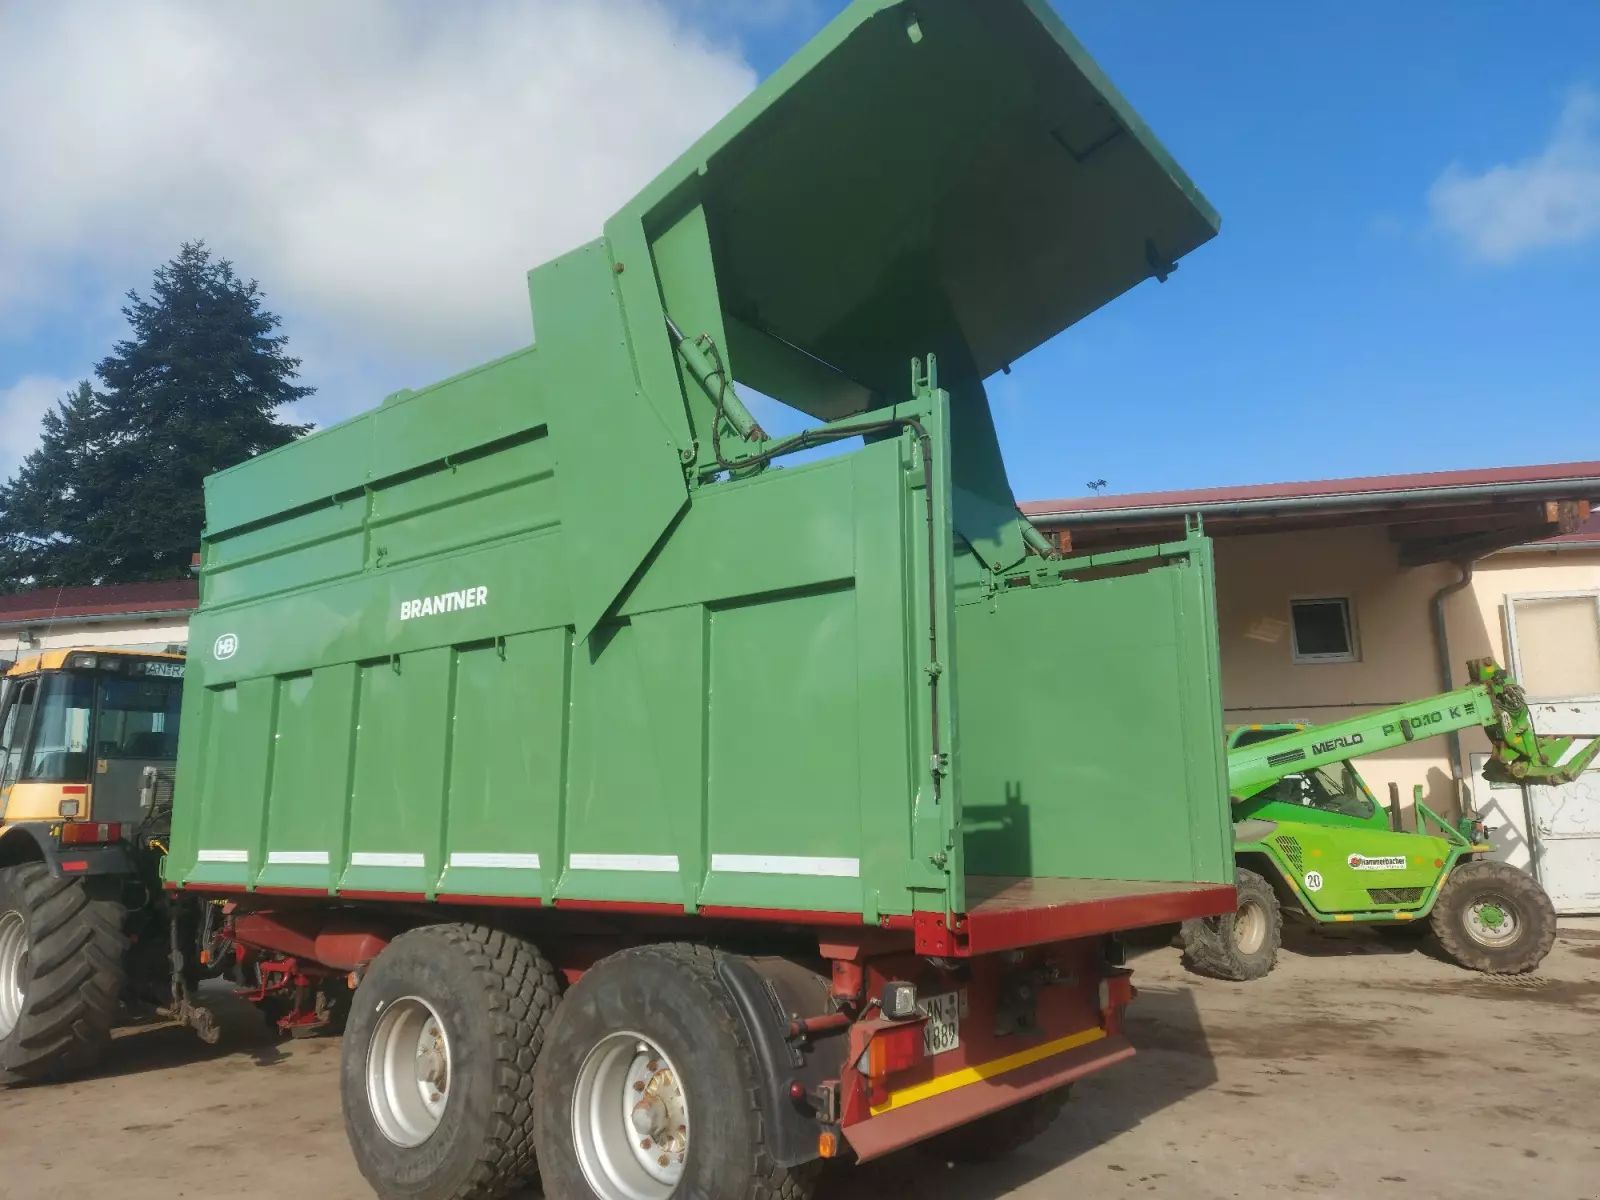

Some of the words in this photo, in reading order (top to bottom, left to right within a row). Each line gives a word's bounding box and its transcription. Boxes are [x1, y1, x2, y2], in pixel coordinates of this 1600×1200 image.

[400, 586, 488, 620] BRANTNER
[1312, 733, 1364, 756] MERLO
[1382, 721, 1394, 737] P
[1449, 706, 1461, 719] K
[1307, 874, 1321, 888] 20
[927, 998, 943, 1024] AN
[933, 1022, 956, 1050] 889
